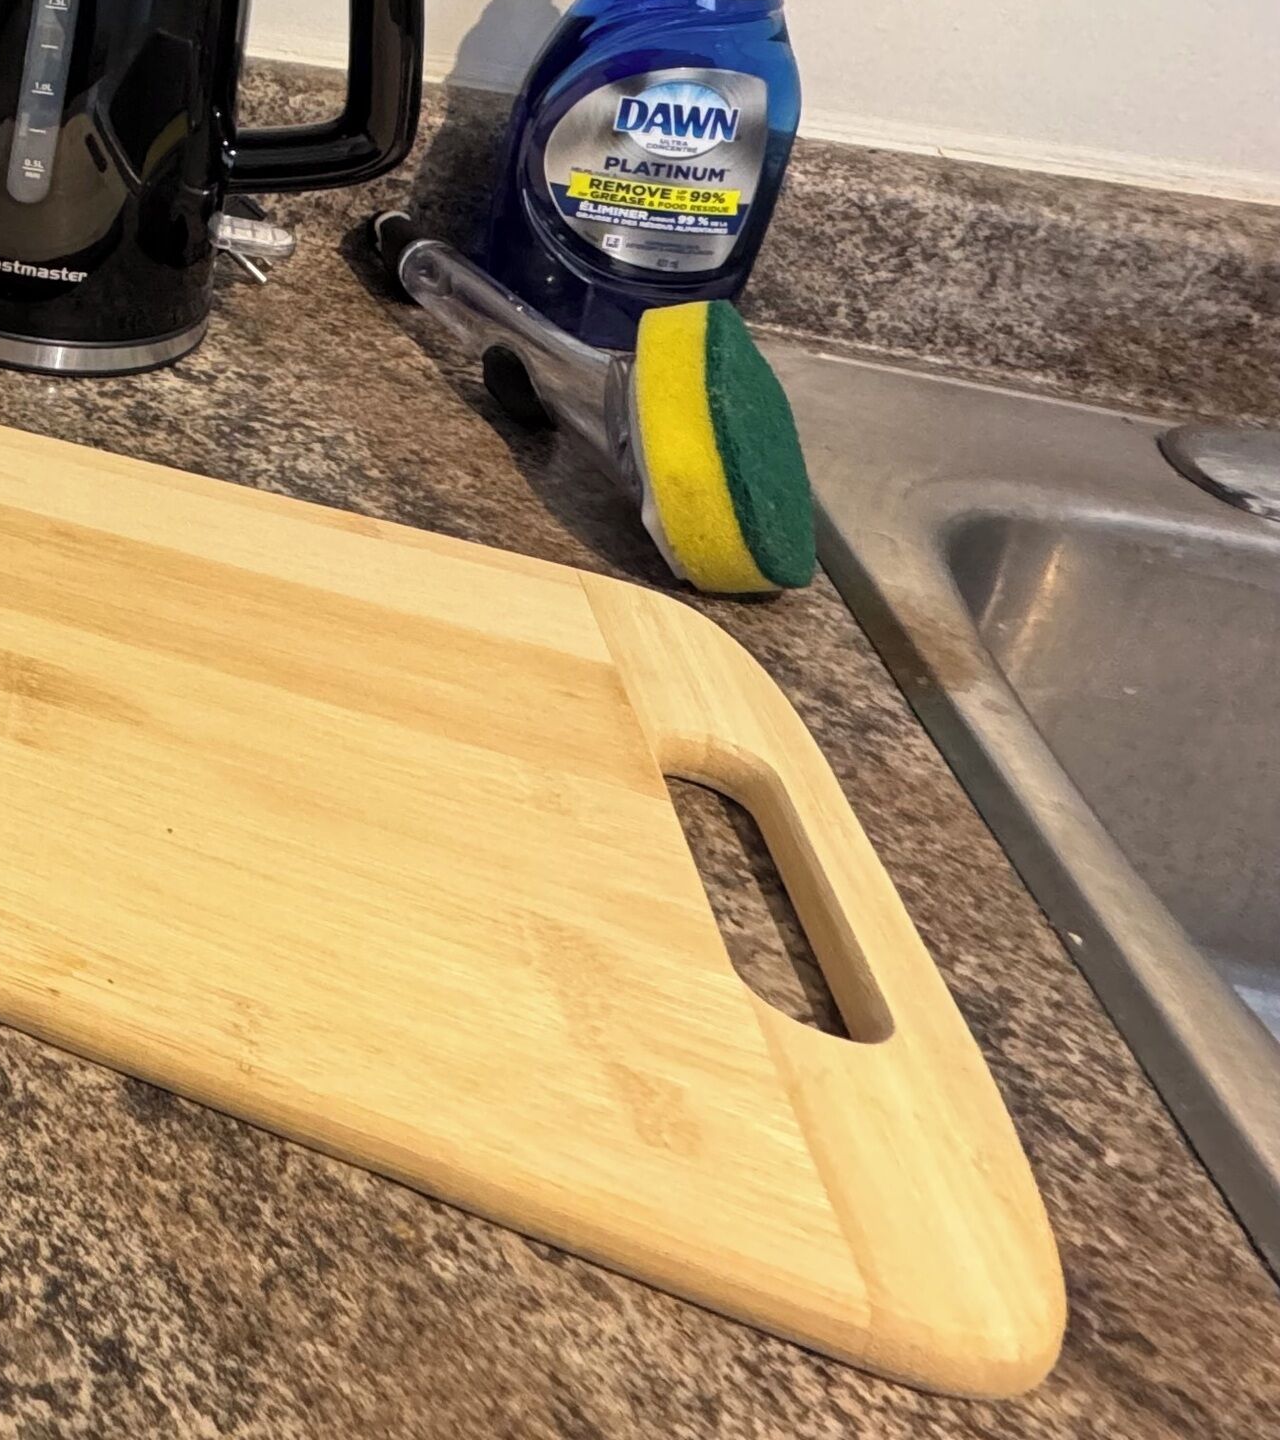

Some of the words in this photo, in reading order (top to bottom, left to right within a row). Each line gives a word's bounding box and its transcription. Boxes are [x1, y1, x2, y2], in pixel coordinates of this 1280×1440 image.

[34, 81, 53, 92] 1.0L
[615, 96, 739, 141] DAWN
[604, 156, 727, 182] PLATINUM
[589, 178, 673, 200] REMOVE
[689, 190, 726, 204] 99%
[590, 190, 646, 206] GREASE
[657, 201, 688, 210] FOOD
